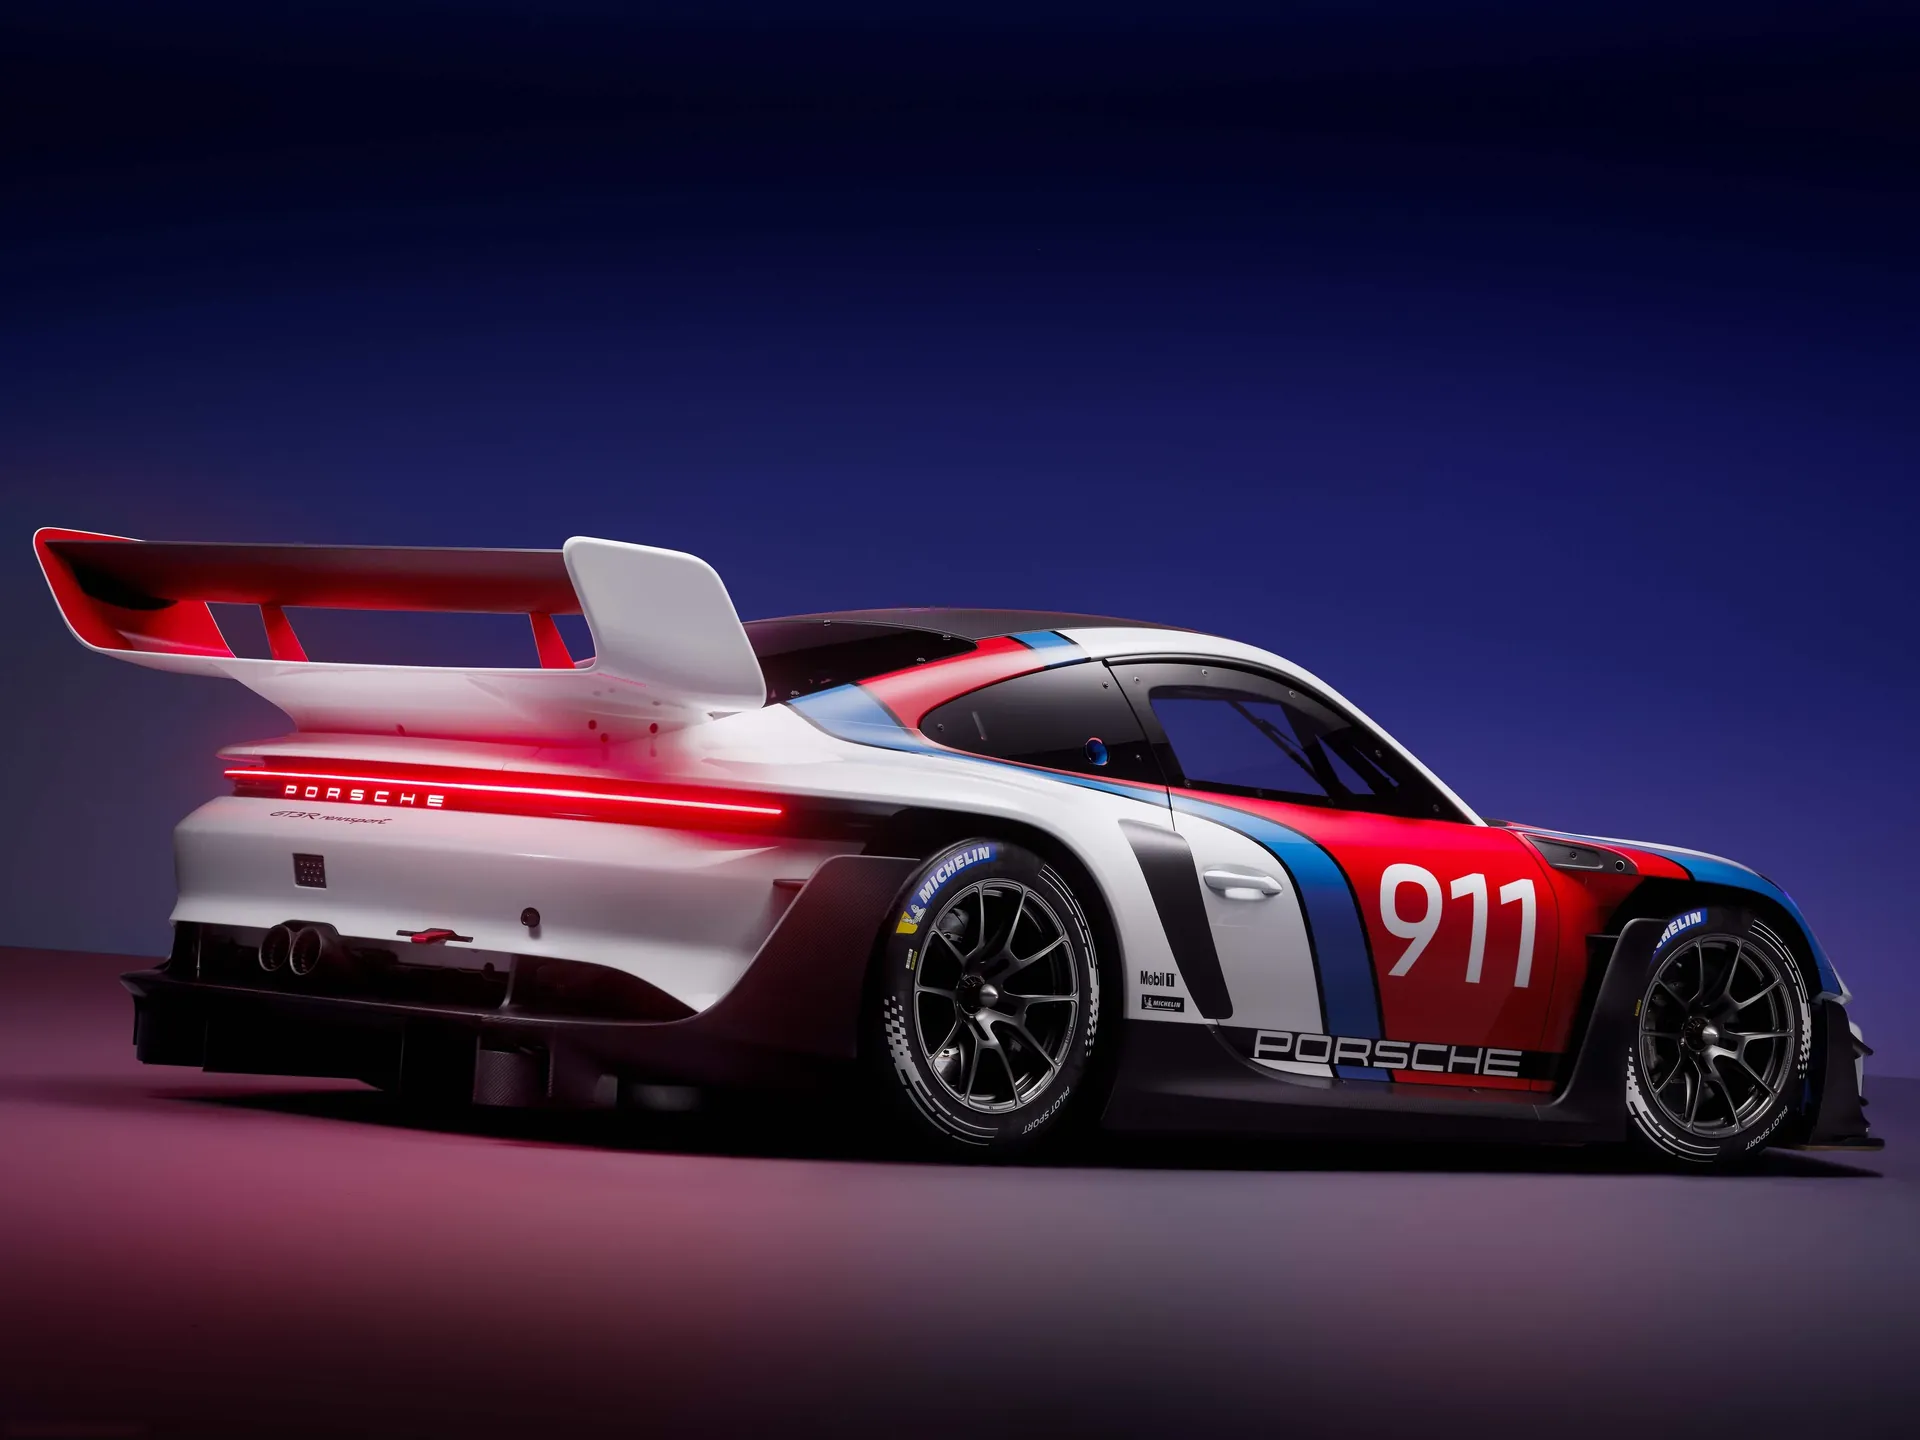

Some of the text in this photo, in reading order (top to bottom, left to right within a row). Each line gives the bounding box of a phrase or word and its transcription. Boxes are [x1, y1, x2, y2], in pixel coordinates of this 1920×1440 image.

[284, 784, 445, 807] PORSCHE
[919, 846, 990, 904] MICHELIN
[1379, 863, 1537, 989] 911
[1654, 911, 1702, 953] HELIN
[1140, 970, 1165, 986] Mobil
[1152, 1000, 1181, 1008] MICHELIN
[1253, 1029, 1523, 1078] PORSCHE
[1021, 1085, 1071, 1135] PILOT SPORT
[1745, 1105, 1788, 1151] PILOT SPORT
